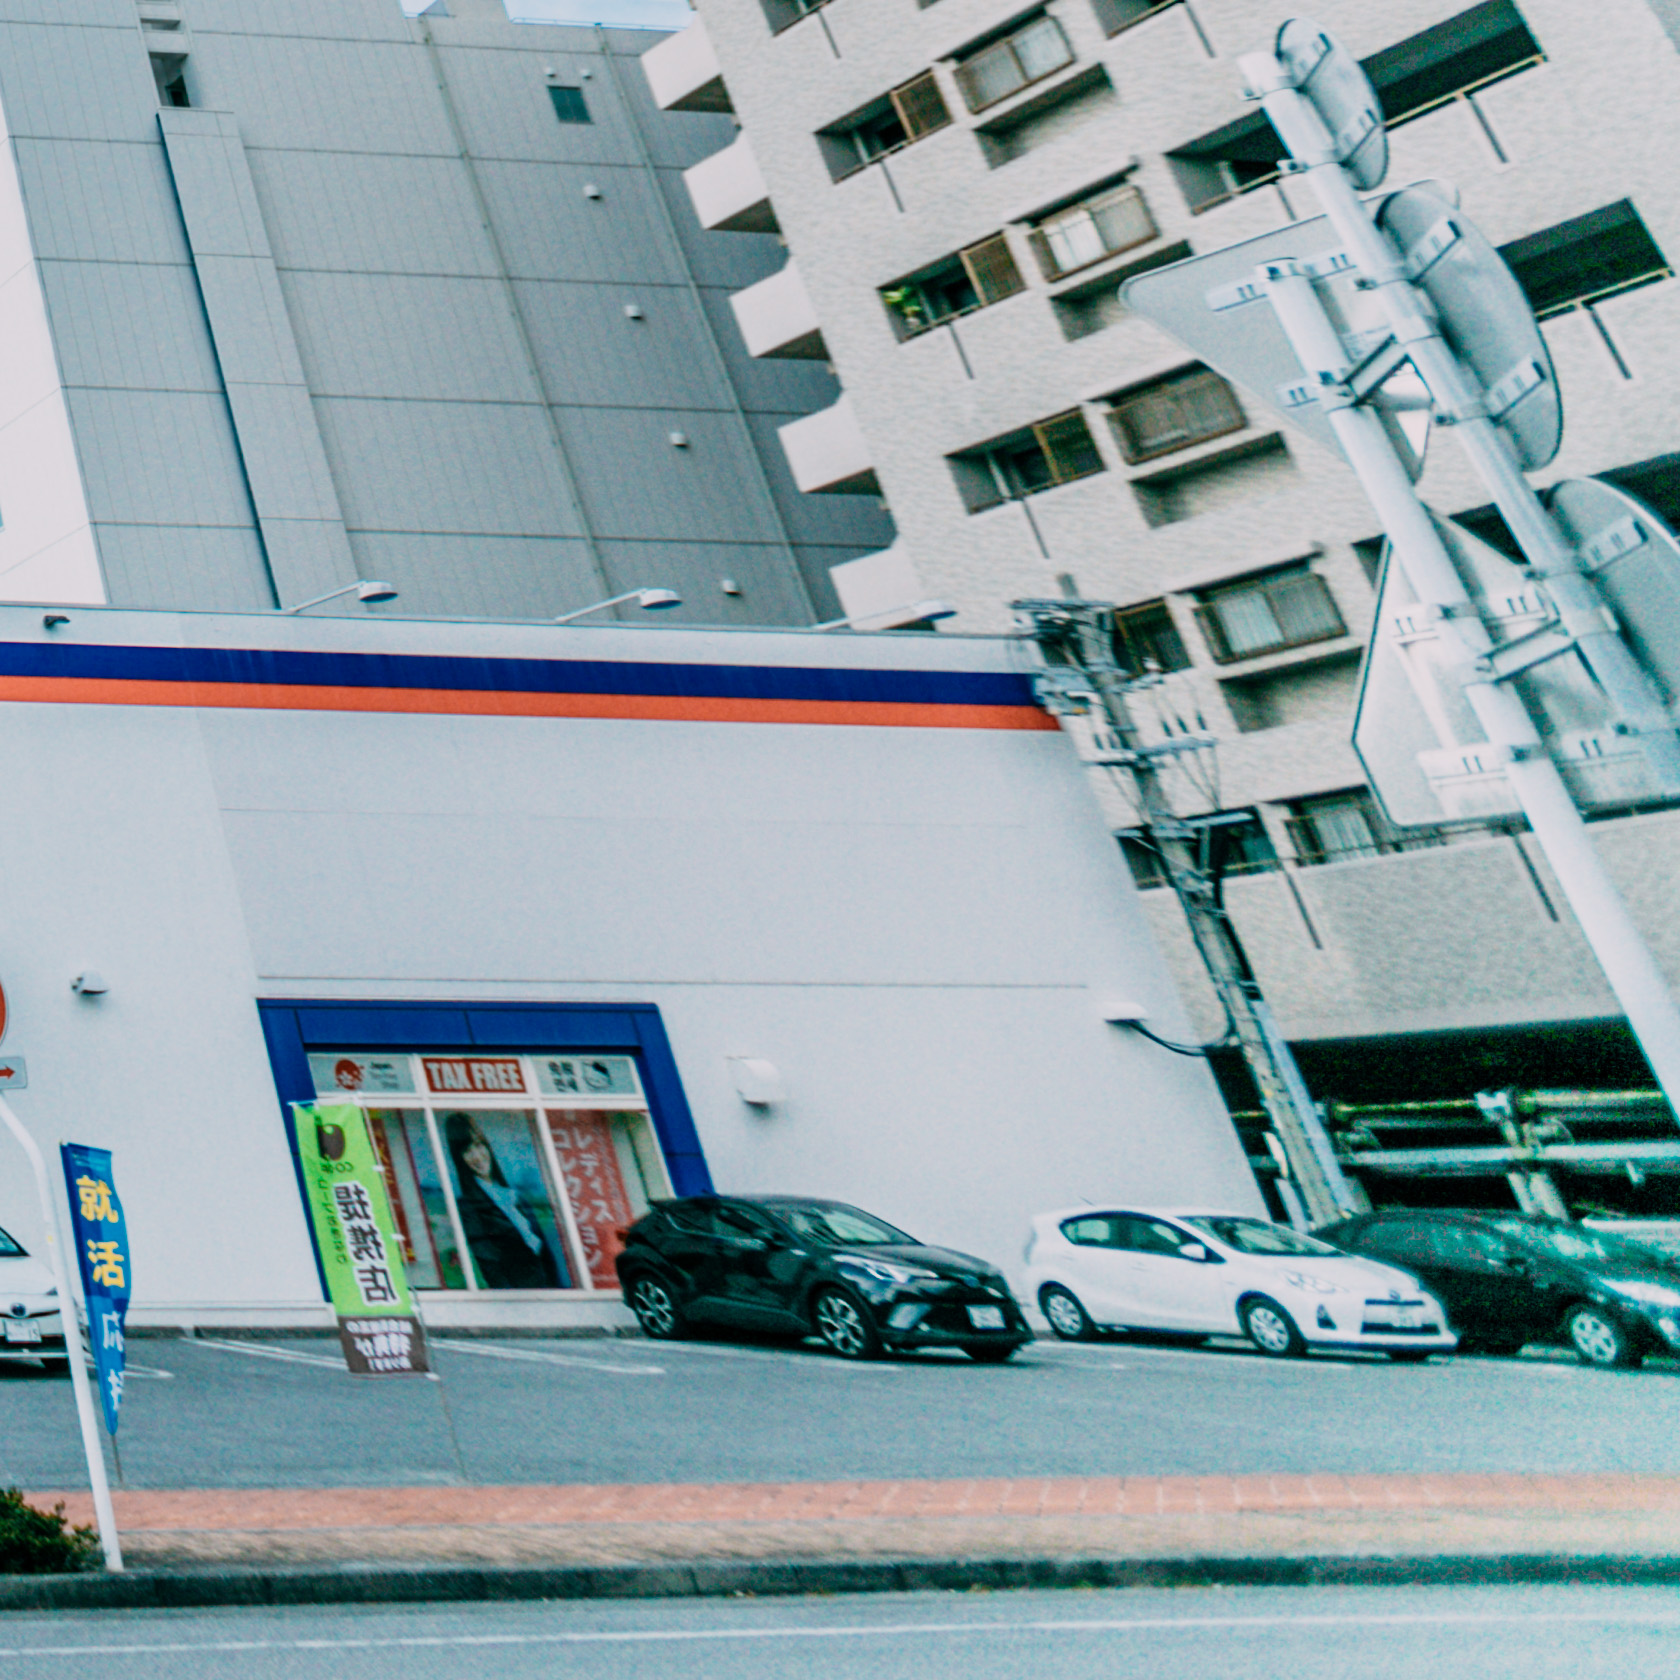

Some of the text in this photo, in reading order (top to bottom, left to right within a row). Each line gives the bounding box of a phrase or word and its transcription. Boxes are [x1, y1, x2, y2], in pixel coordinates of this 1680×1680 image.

[426, 1062, 524, 1090] TAX FREE
[550, 1128, 603, 1269] コレクション
[573, 1126, 615, 1223] レディス
